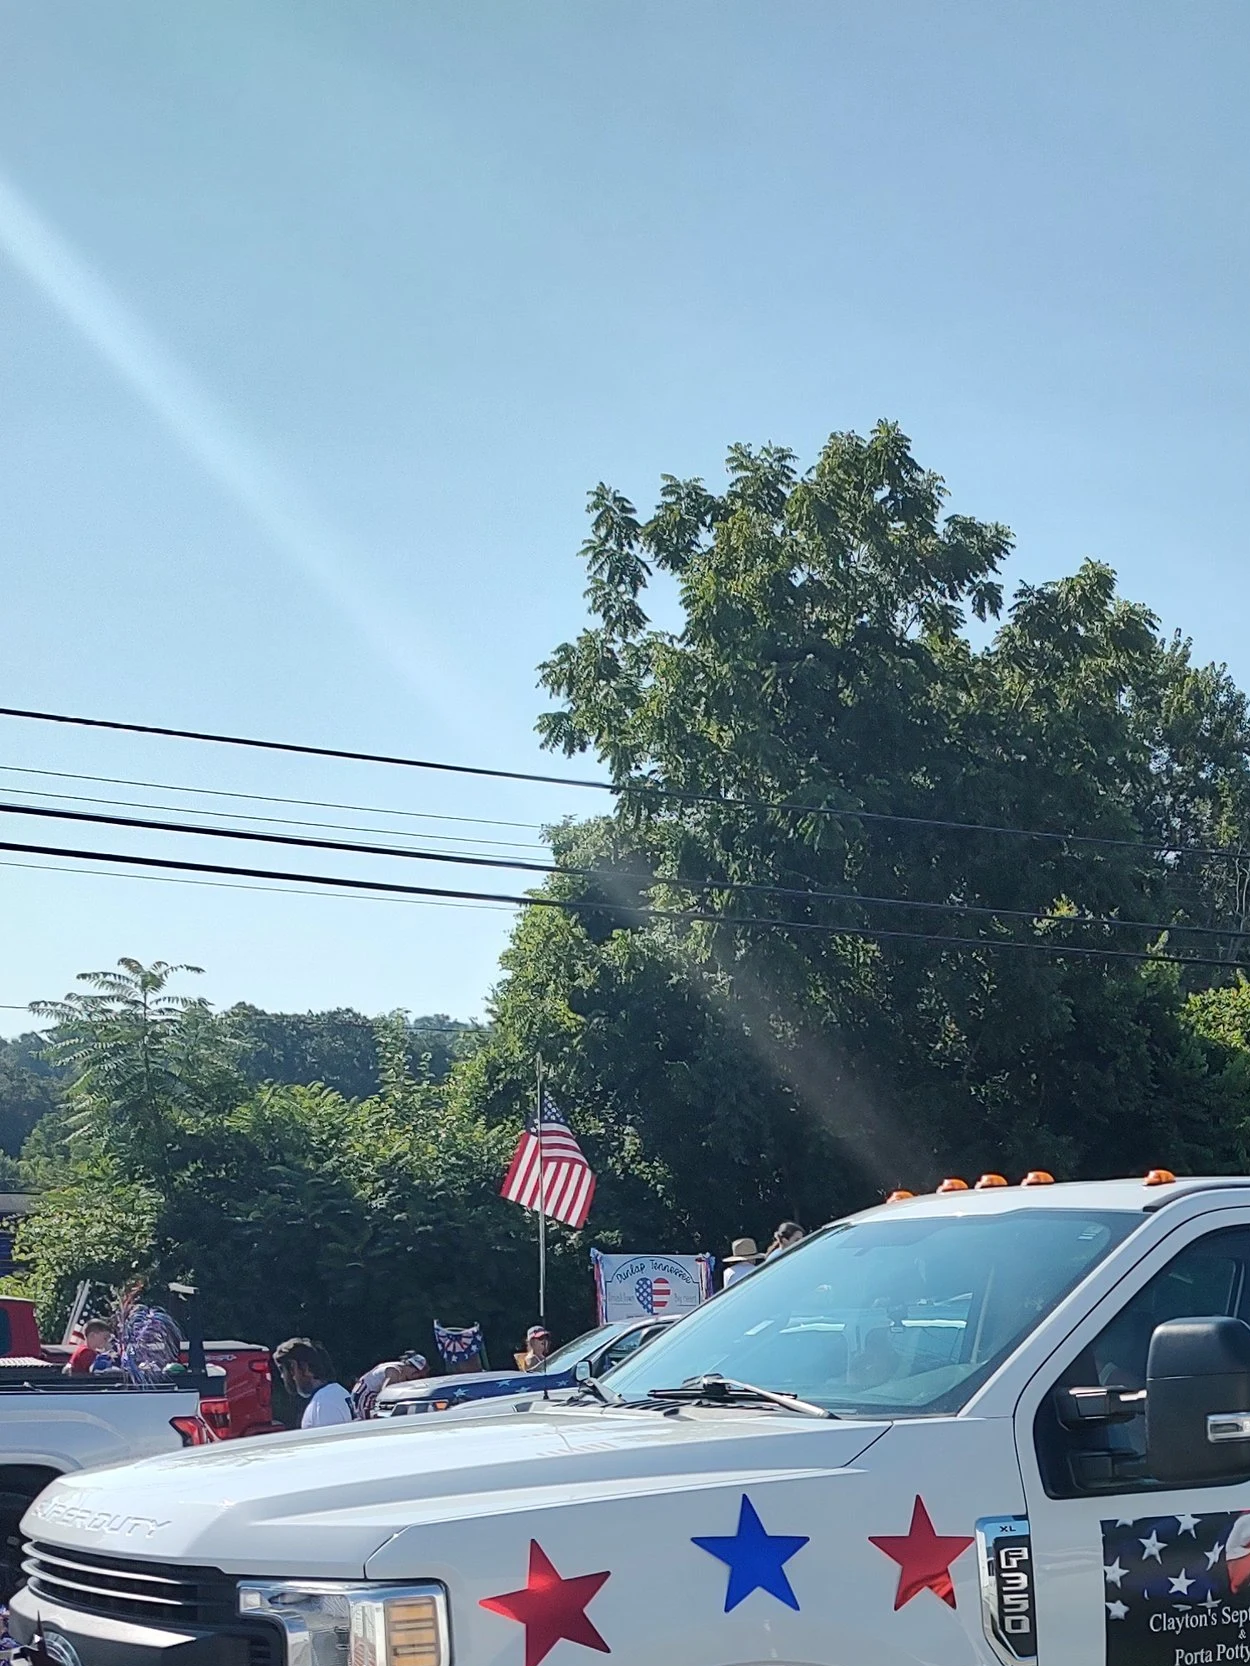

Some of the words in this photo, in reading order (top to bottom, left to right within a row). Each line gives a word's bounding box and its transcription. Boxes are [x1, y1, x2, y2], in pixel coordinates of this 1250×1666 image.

[616, 1263, 646, 1284] Dunlap
[1149, 1608, 1218, 1635] Clayton's
[1238, 1628, 1247, 1640] &
[1174, 1648, 1214, 1666] Porta
